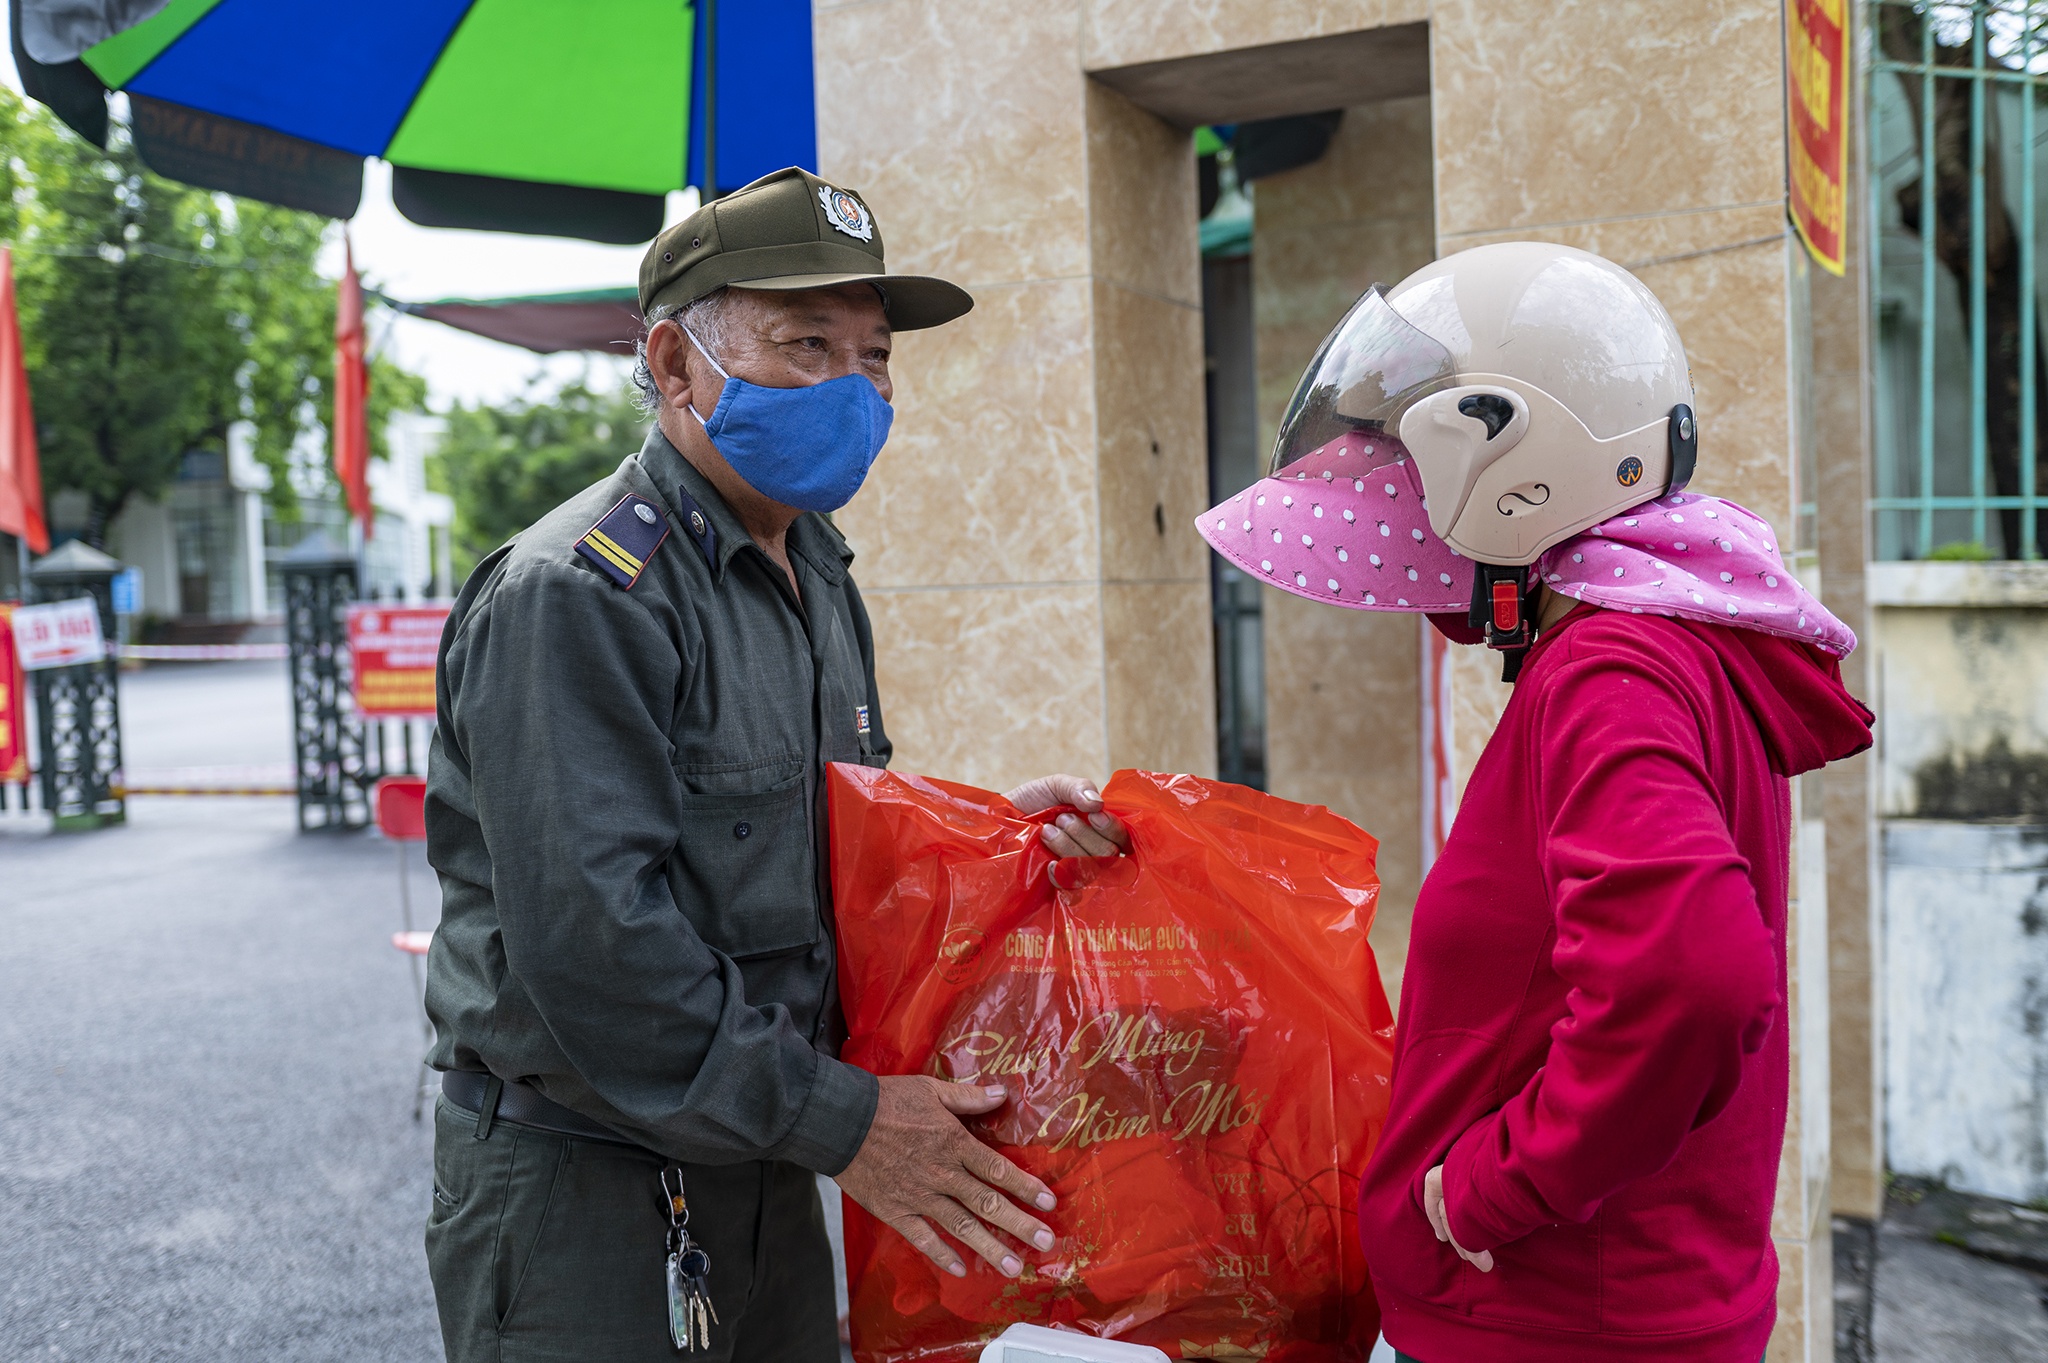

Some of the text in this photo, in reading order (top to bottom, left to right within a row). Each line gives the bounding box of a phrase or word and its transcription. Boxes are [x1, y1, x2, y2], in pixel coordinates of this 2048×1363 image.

[1004, 926, 1044, 959] CÔNG
[1077, 919, 1117, 952] PHẦN
[1120, 922, 1151, 952] TÂM
[1155, 920, 1185, 951] ĐỨC
[936, 1011, 1206, 1083] Chúc Mừng
[1037, 1080, 1271, 1155] Năm Mới
